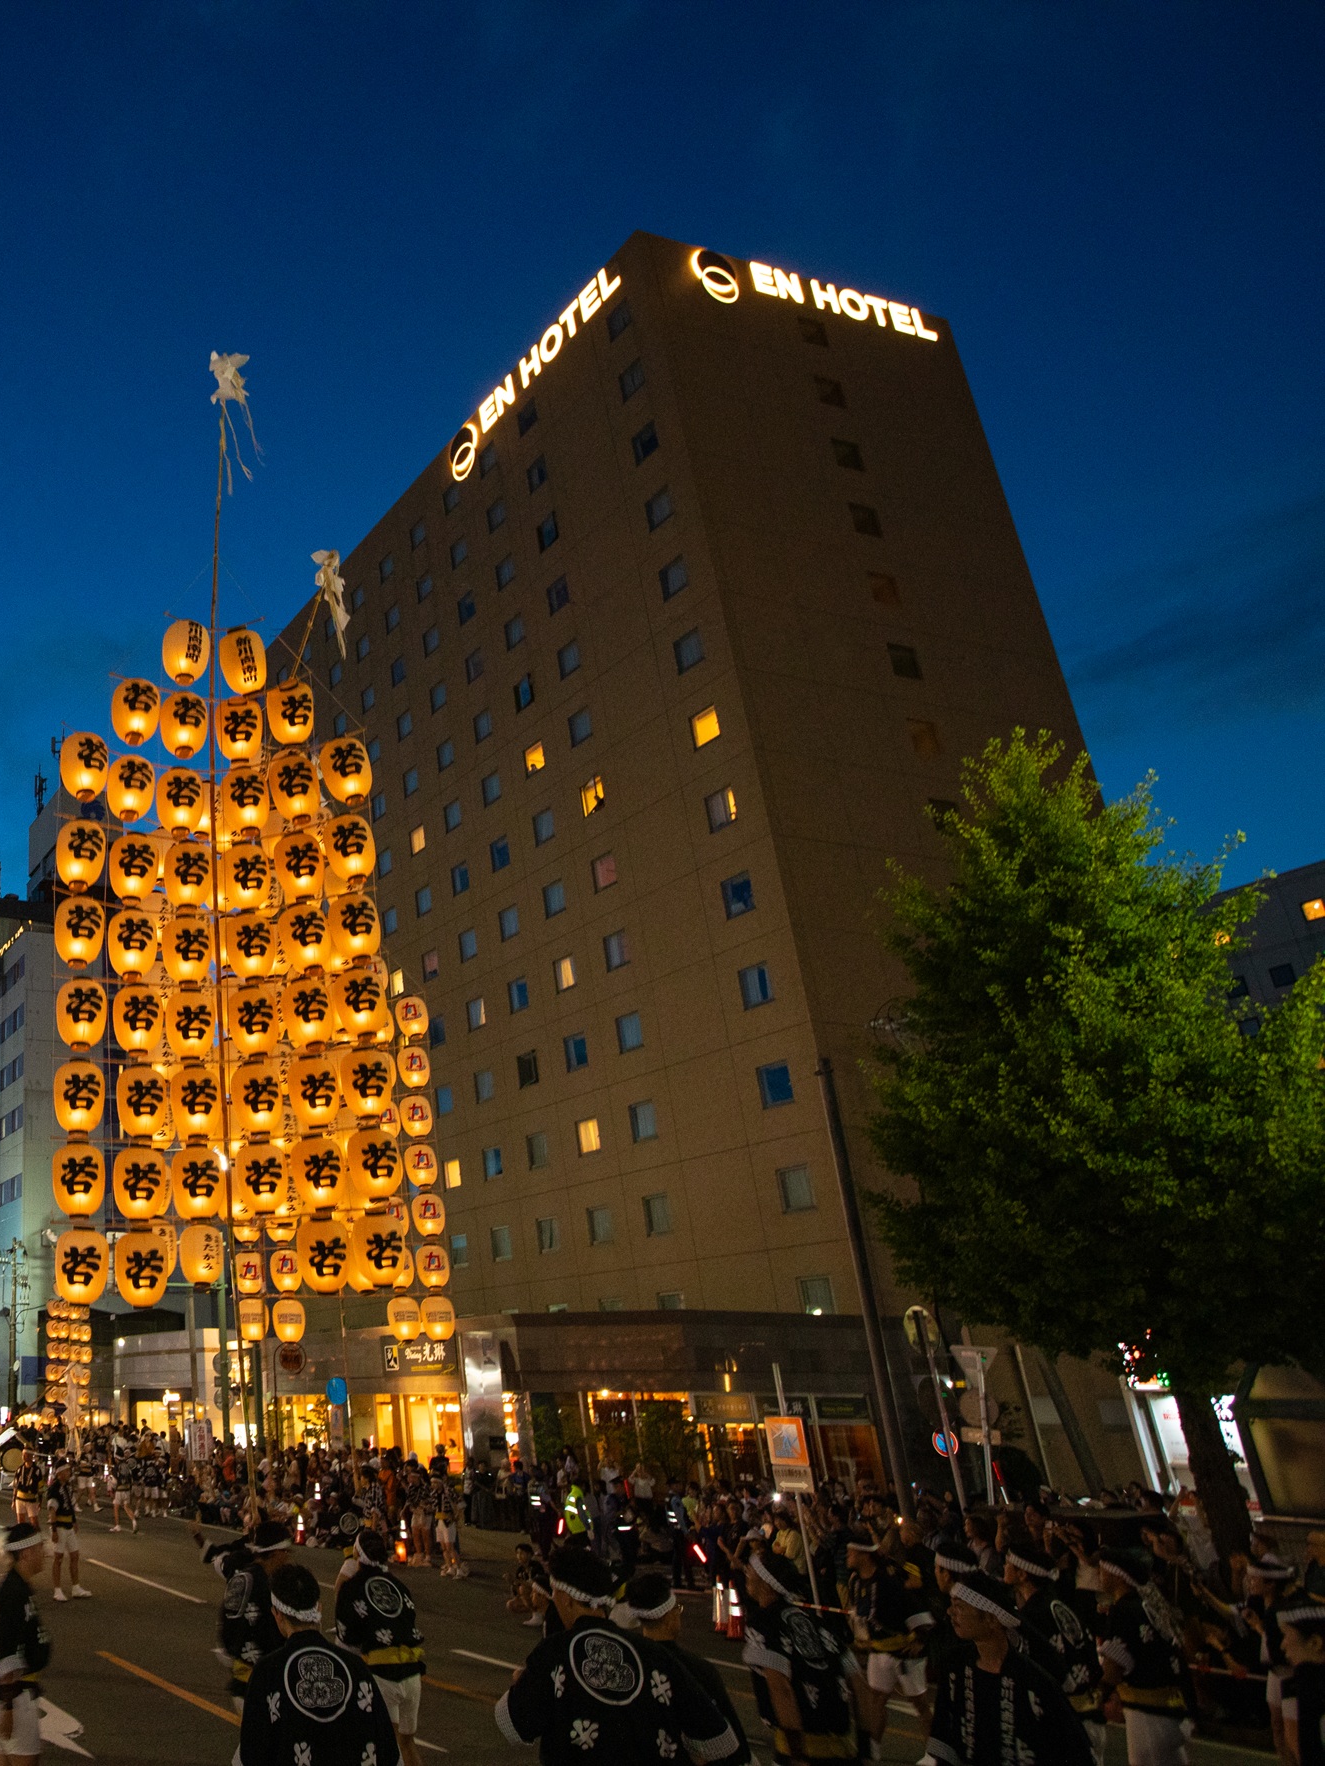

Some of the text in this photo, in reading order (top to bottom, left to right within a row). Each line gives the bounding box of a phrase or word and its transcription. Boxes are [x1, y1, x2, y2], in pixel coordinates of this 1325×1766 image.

[749, 261, 939, 342] EN HOTEL
[479, 266, 622, 434] EN HOTEL
[124, 683, 156, 712] 若
[174, 697, 205, 727] 若
[282, 694, 311, 726] 若
[224, 709, 257, 742] 若
[78, 738, 107, 770] 若
[331, 743, 364, 777] 若
[119, 760, 152, 790] 若
[167, 777, 200, 806] 若
[231, 775, 264, 807] 若
[278, 762, 312, 797] 若
[69, 828, 103, 860] 若
[332, 822, 367, 857] 若
[119, 844, 155, 877] 若
[175, 852, 209, 885] 若
[234, 855, 266, 889] 若
[286, 843, 319, 877] 若
[67, 905, 101, 939] 若
[118, 918, 153, 951] 若
[290, 912, 325, 946] 若
[341, 901, 375, 935] 若
[175, 929, 209, 961] 若
[237, 923, 270, 957] 若
[66, 988, 102, 1022] 若
[293, 988, 328, 1022] 若
[344, 977, 380, 1012] 若
[403, 1002, 417, 1018] 力
[123, 995, 159, 1031] 若
[176, 1005, 211, 1039] 若
[238, 999, 273, 1034] 若
[408, 1052, 422, 1069] 力
[64, 1074, 100, 1110] 若
[181, 1079, 217, 1114] 若
[244, 1077, 278, 1113] 若
[301, 1072, 335, 1108] 若
[353, 1062, 387, 1098] 若
[127, 1079, 163, 1116] 若
[410, 1103, 424, 1120] 力
[304, 1150, 340, 1188] 若
[362, 1141, 397, 1178] 若
[415, 1150, 429, 1165] 力
[61, 1156, 98, 1194] 若
[123, 1163, 161, 1200] 若
[183, 1160, 219, 1197] 若
[246, 1158, 282, 1194] 若
[422, 1200, 436, 1216] 力
[62, 1247, 101, 1286] 若
[202, 1233, 214, 1271] きたかみ
[279, 1255, 293, 1271] 力
[309, 1238, 346, 1276] 若
[367, 1231, 402, 1269] 若
[425, 1252, 440, 1268] 力
[126, 1250, 163, 1288] 若
[243, 1261, 256, 1279] 力
[423, 1342, 446, 1361] 光琳
